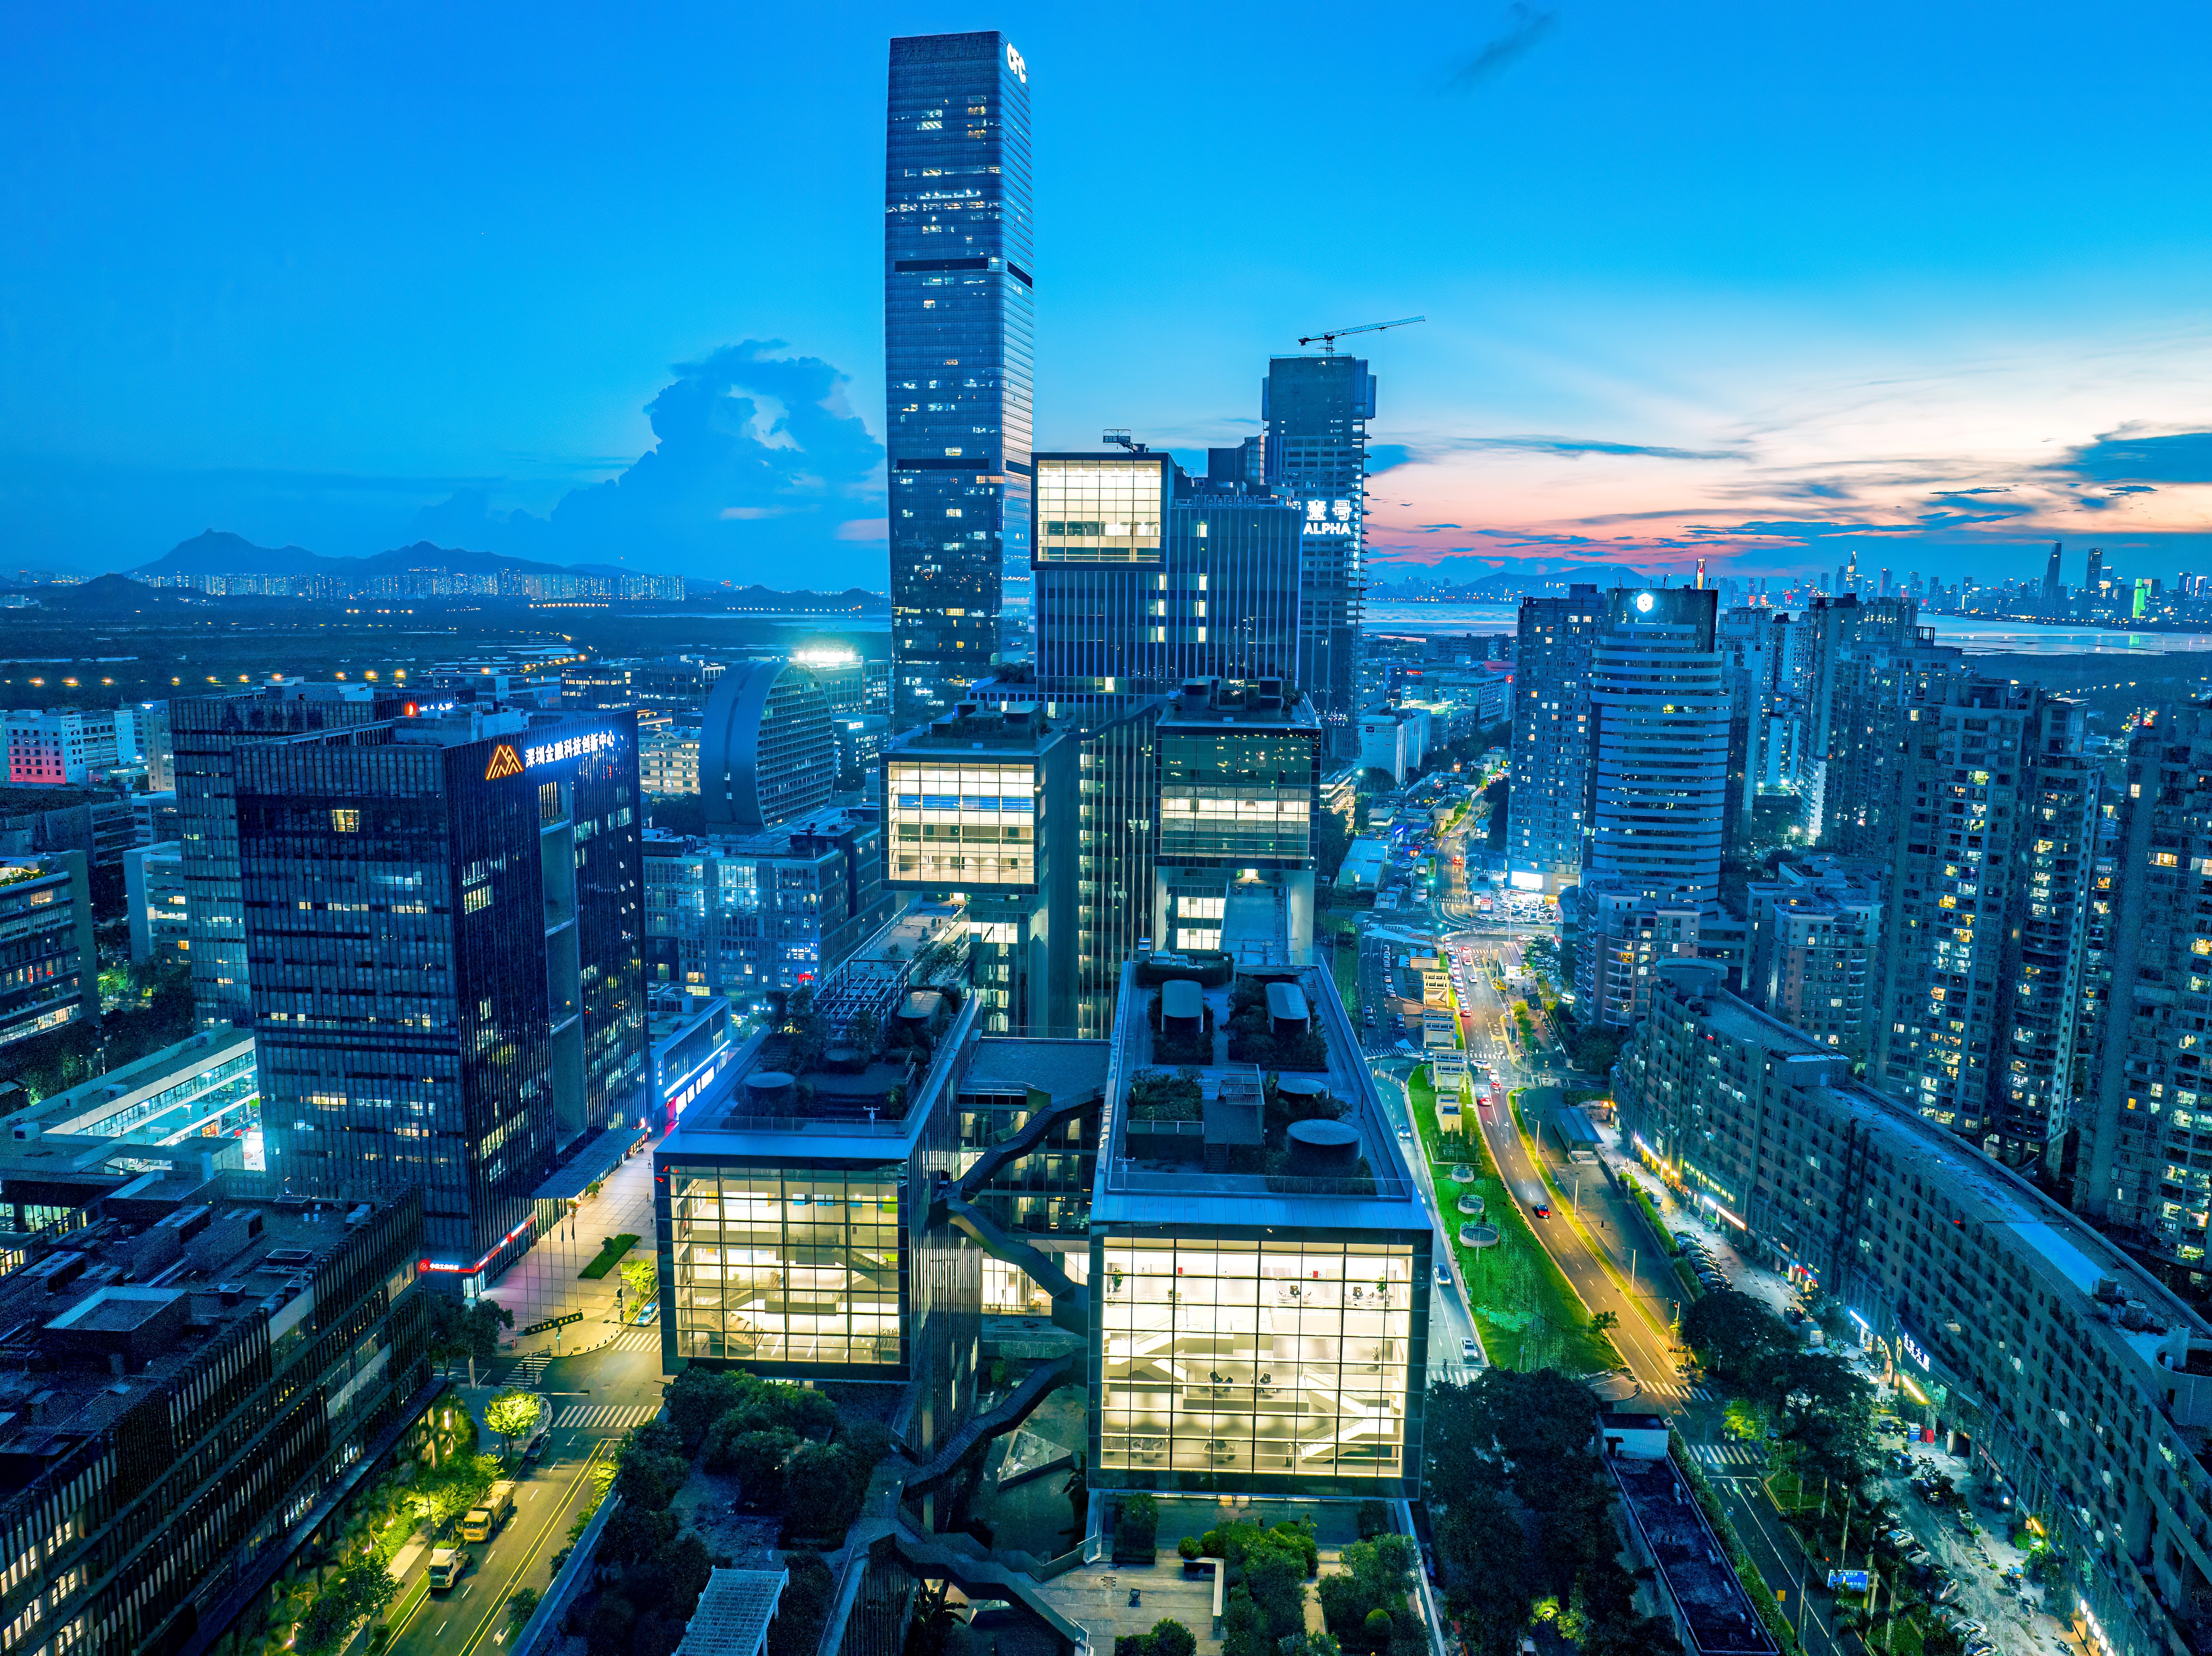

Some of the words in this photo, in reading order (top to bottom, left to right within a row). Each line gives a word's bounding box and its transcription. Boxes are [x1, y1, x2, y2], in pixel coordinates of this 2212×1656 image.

[1303, 523, 1351, 535] ALPHA
[525, 730, 616, 768] 深圳金融科技创新中心
